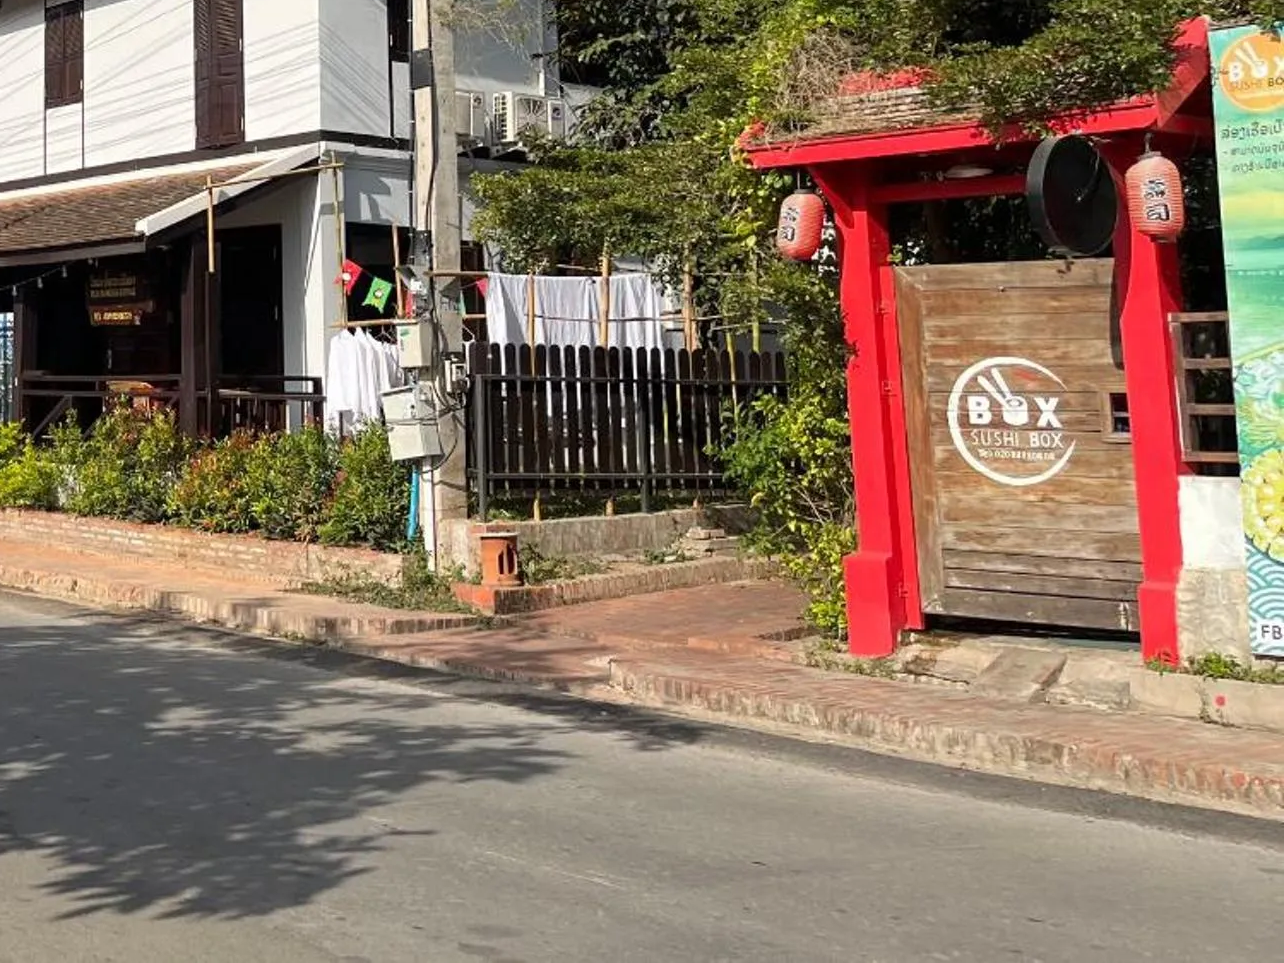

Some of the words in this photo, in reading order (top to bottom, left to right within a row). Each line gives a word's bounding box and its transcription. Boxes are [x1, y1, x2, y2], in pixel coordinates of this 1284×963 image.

[1267, 76, 1284, 87] BO
[966, 395, 1064, 428] BOX
[970, 428, 1020, 447] SUSHI
[1029, 431, 1064, 448] BOX
[1260, 624, 1283, 640] FB
